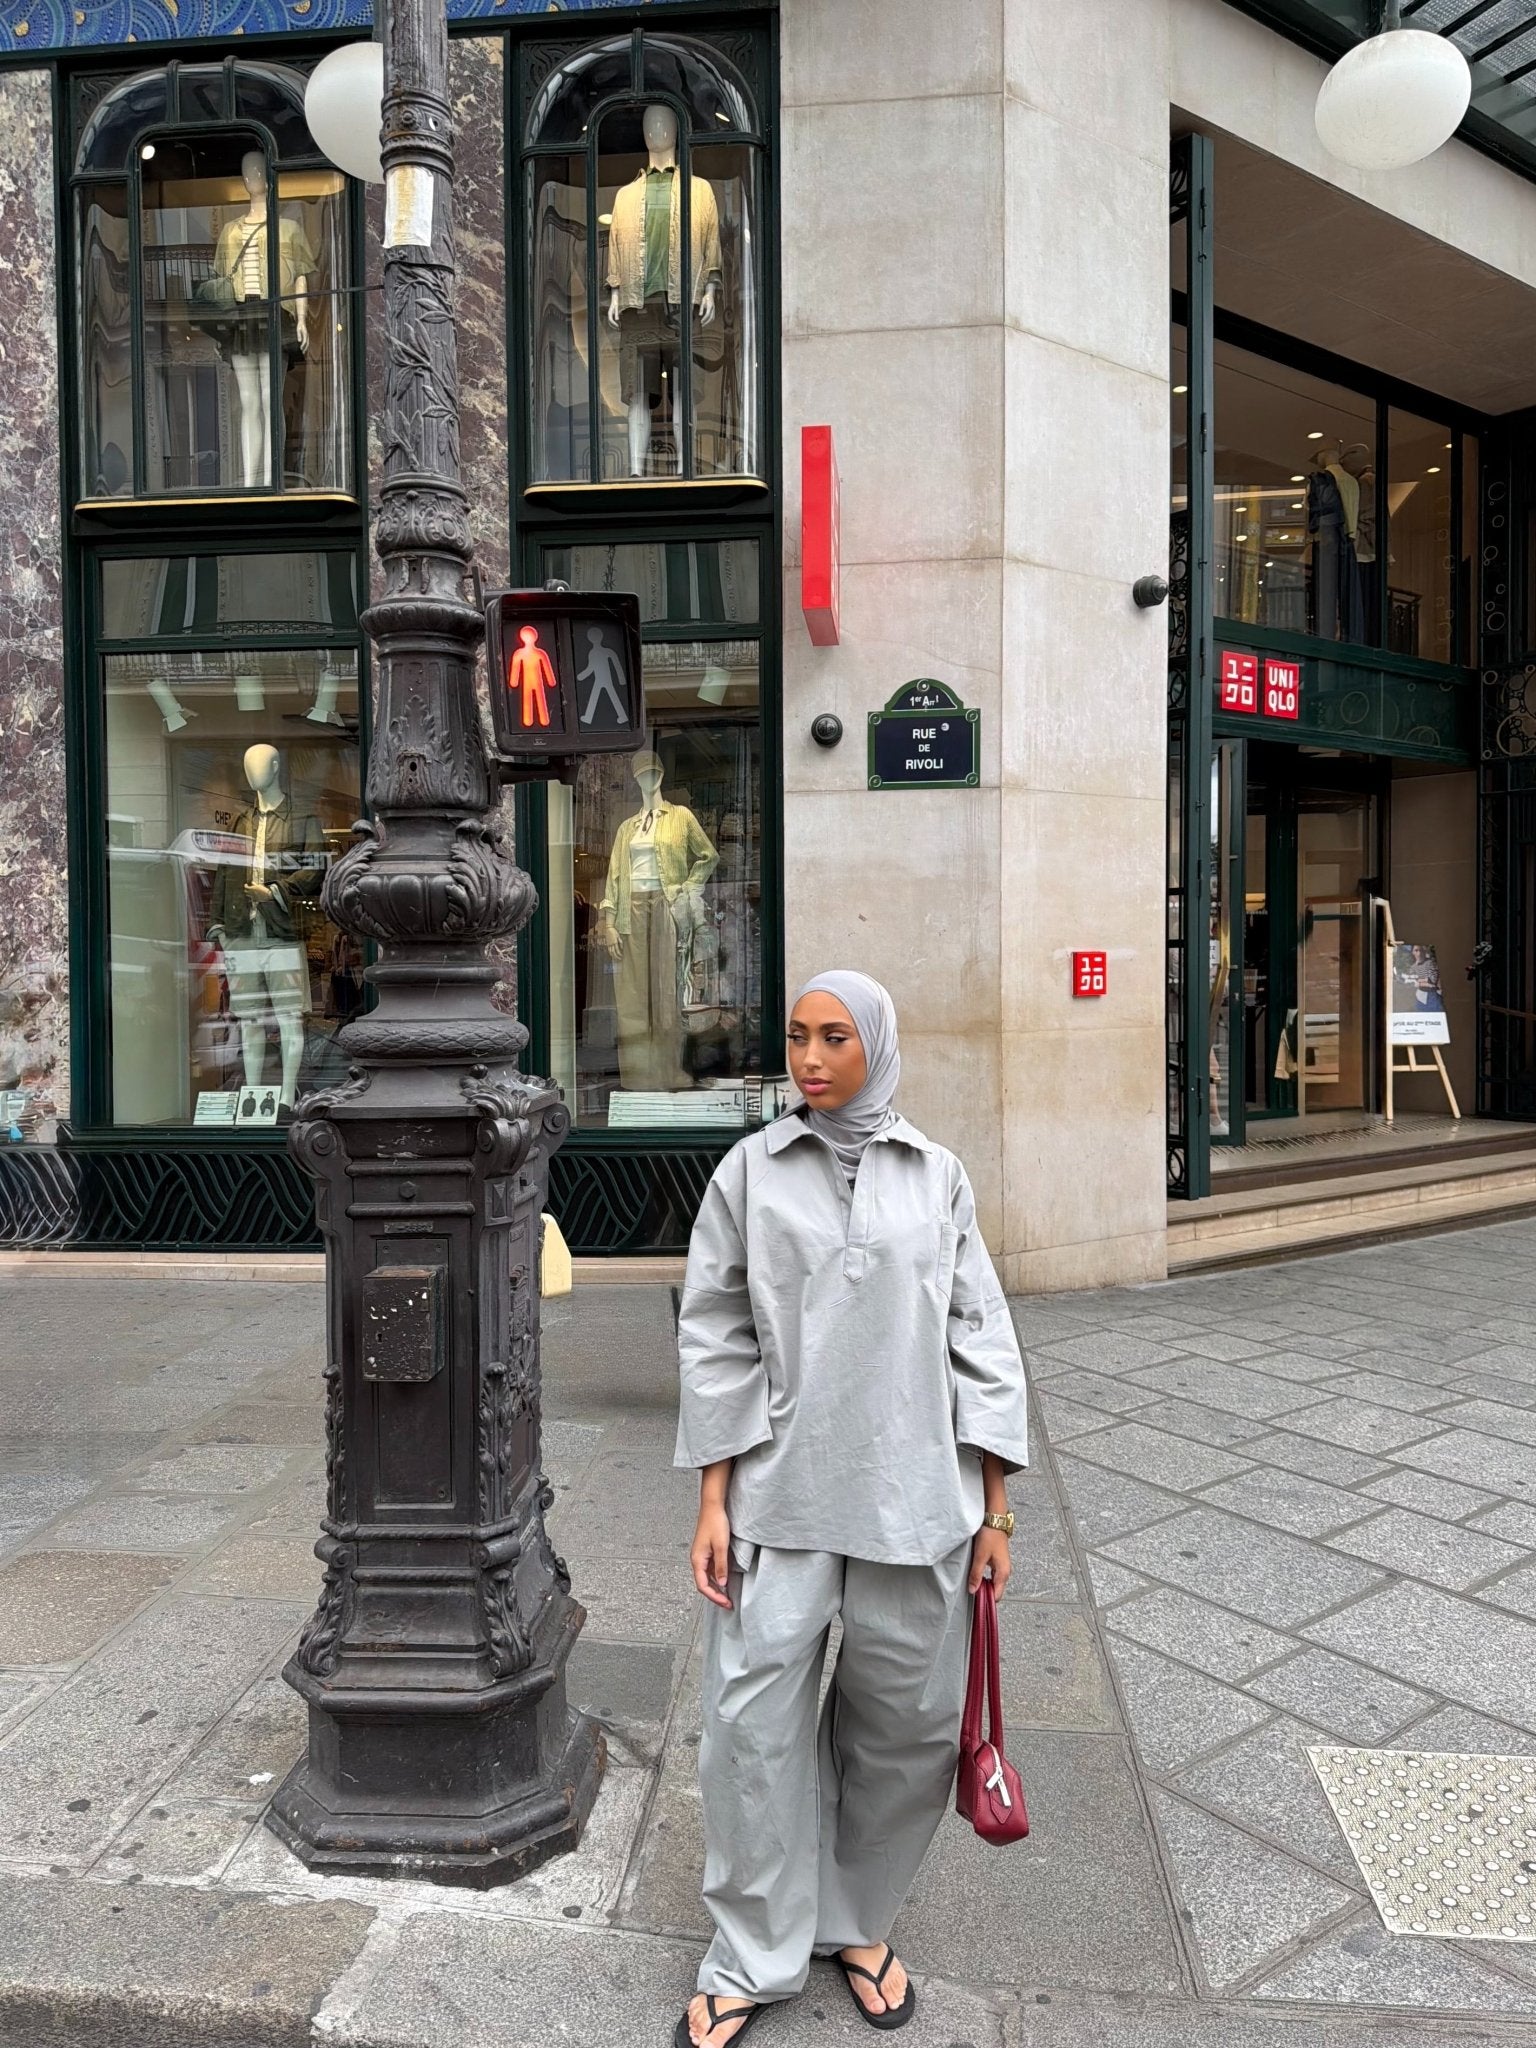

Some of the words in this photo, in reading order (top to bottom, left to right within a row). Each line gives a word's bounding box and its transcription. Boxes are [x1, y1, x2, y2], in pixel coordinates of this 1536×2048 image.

[1268, 666, 1293, 689] UNI
[1268, 690, 1295, 713] QLO
[912, 728, 937, 739] RUE
[918, 744, 931, 752] DE
[905, 758, 944, 770] RIVOLI
